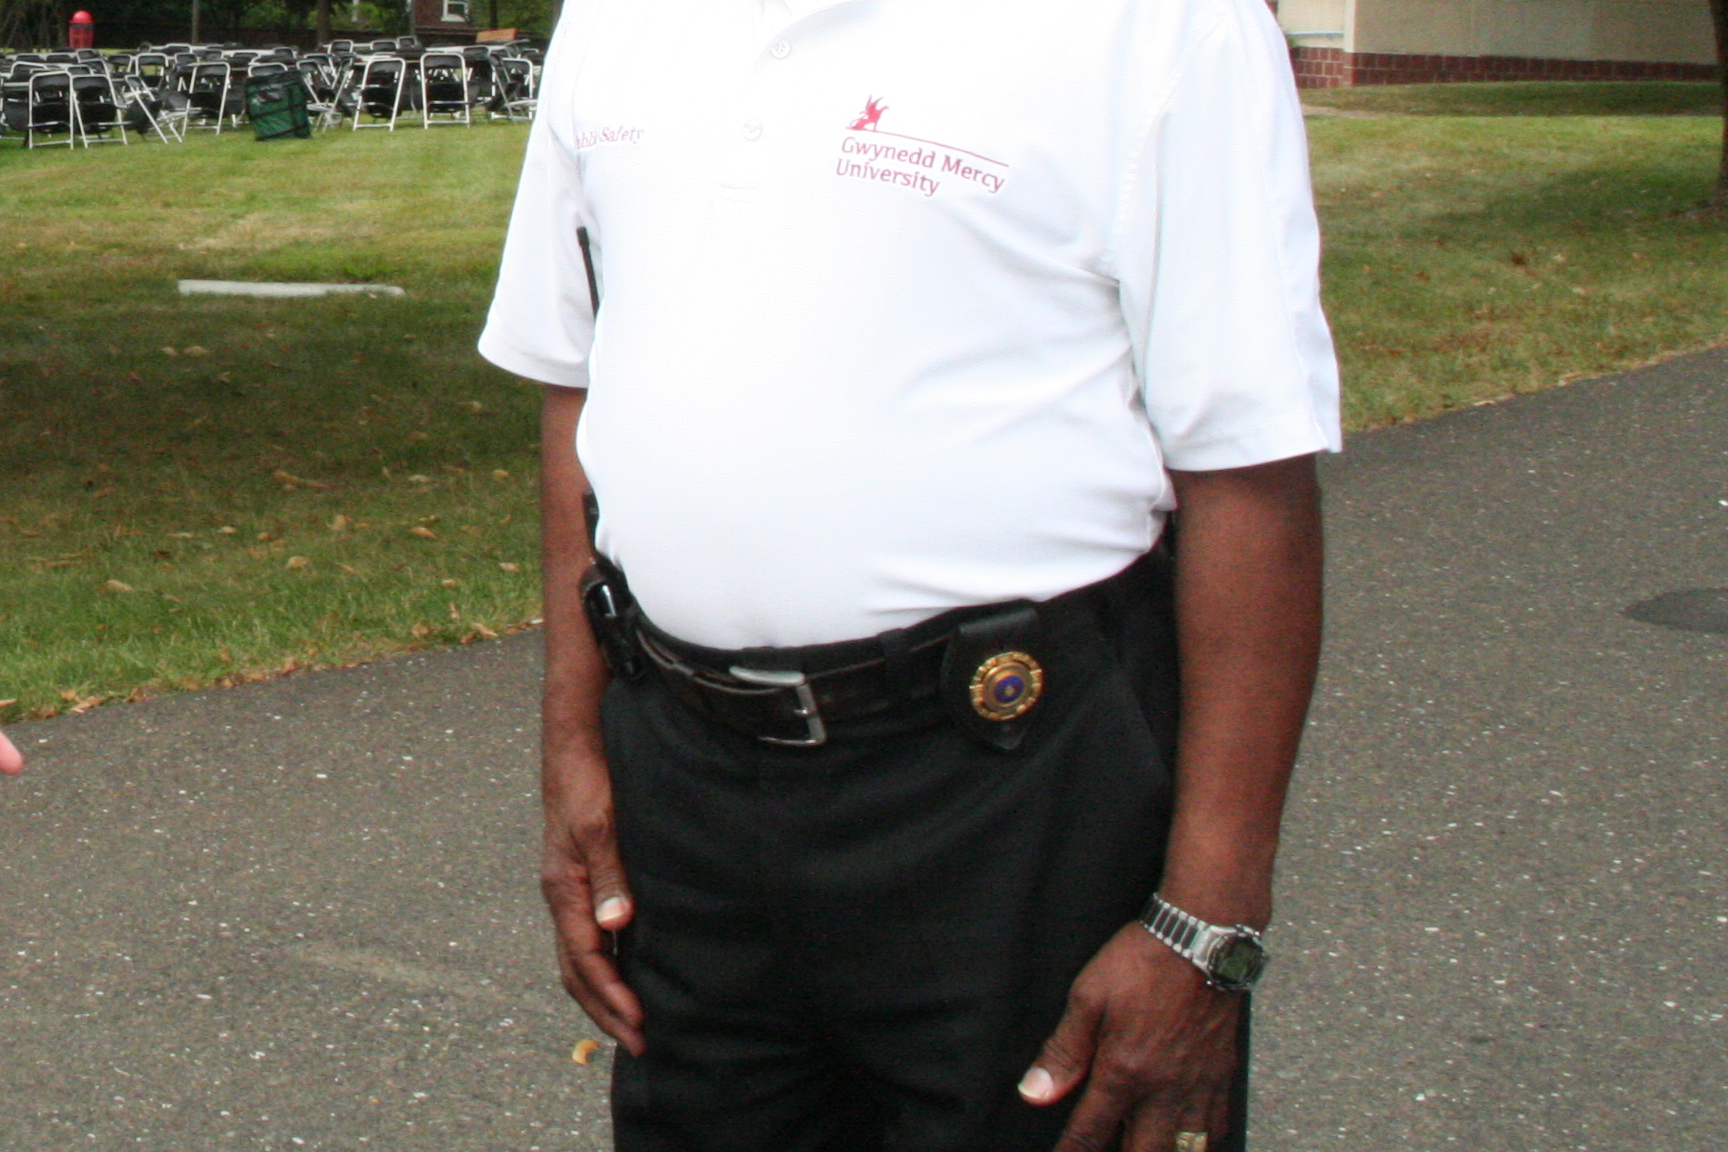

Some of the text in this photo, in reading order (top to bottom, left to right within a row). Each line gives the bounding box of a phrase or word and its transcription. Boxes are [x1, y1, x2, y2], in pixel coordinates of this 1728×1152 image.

[836, 158, 940, 197] University
[841, 136, 1005, 194] Gwynedd Mercy
